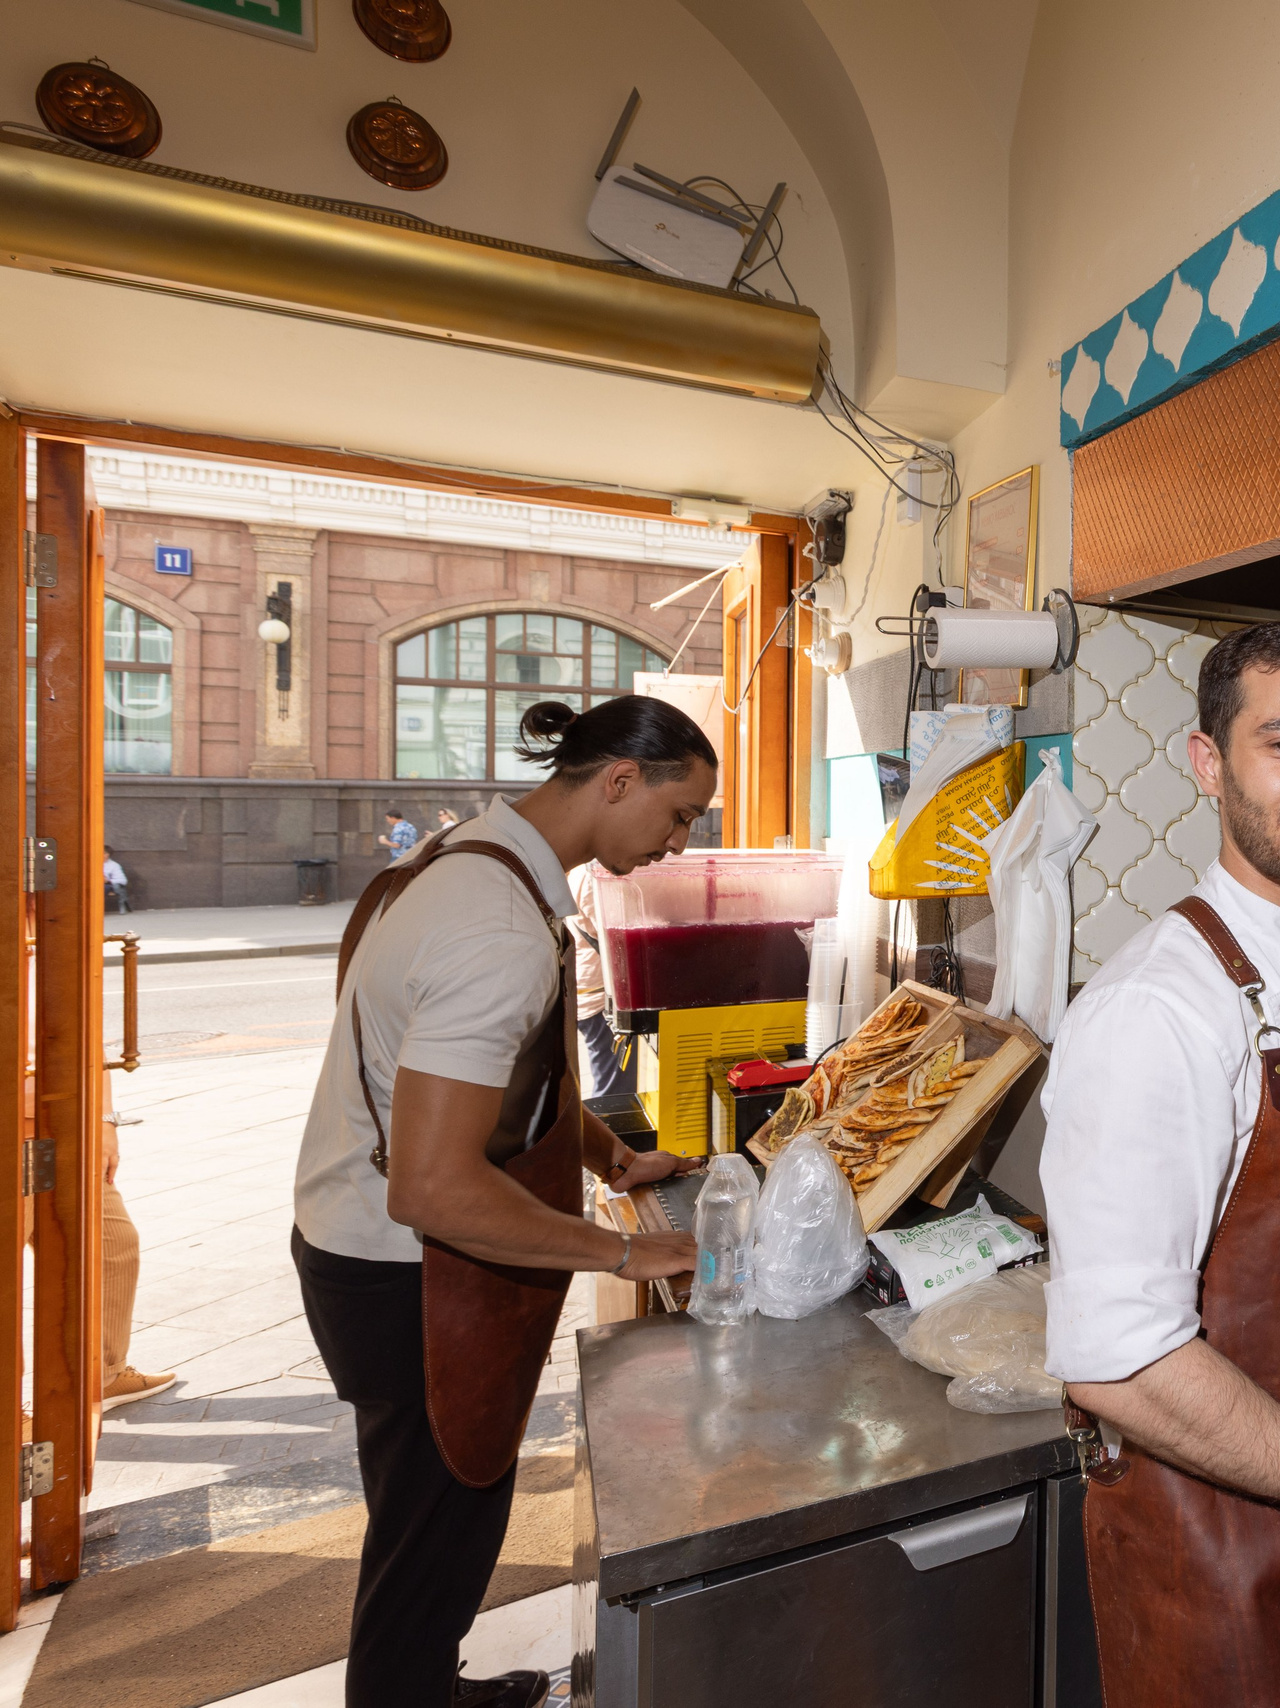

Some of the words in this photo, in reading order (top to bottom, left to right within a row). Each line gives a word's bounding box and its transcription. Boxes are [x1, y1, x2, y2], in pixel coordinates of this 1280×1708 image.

[163, 553, 181, 568] 11
[963, 765, 995, 786] РЕСТОРАН
[945, 783, 962, 797] ADAM
